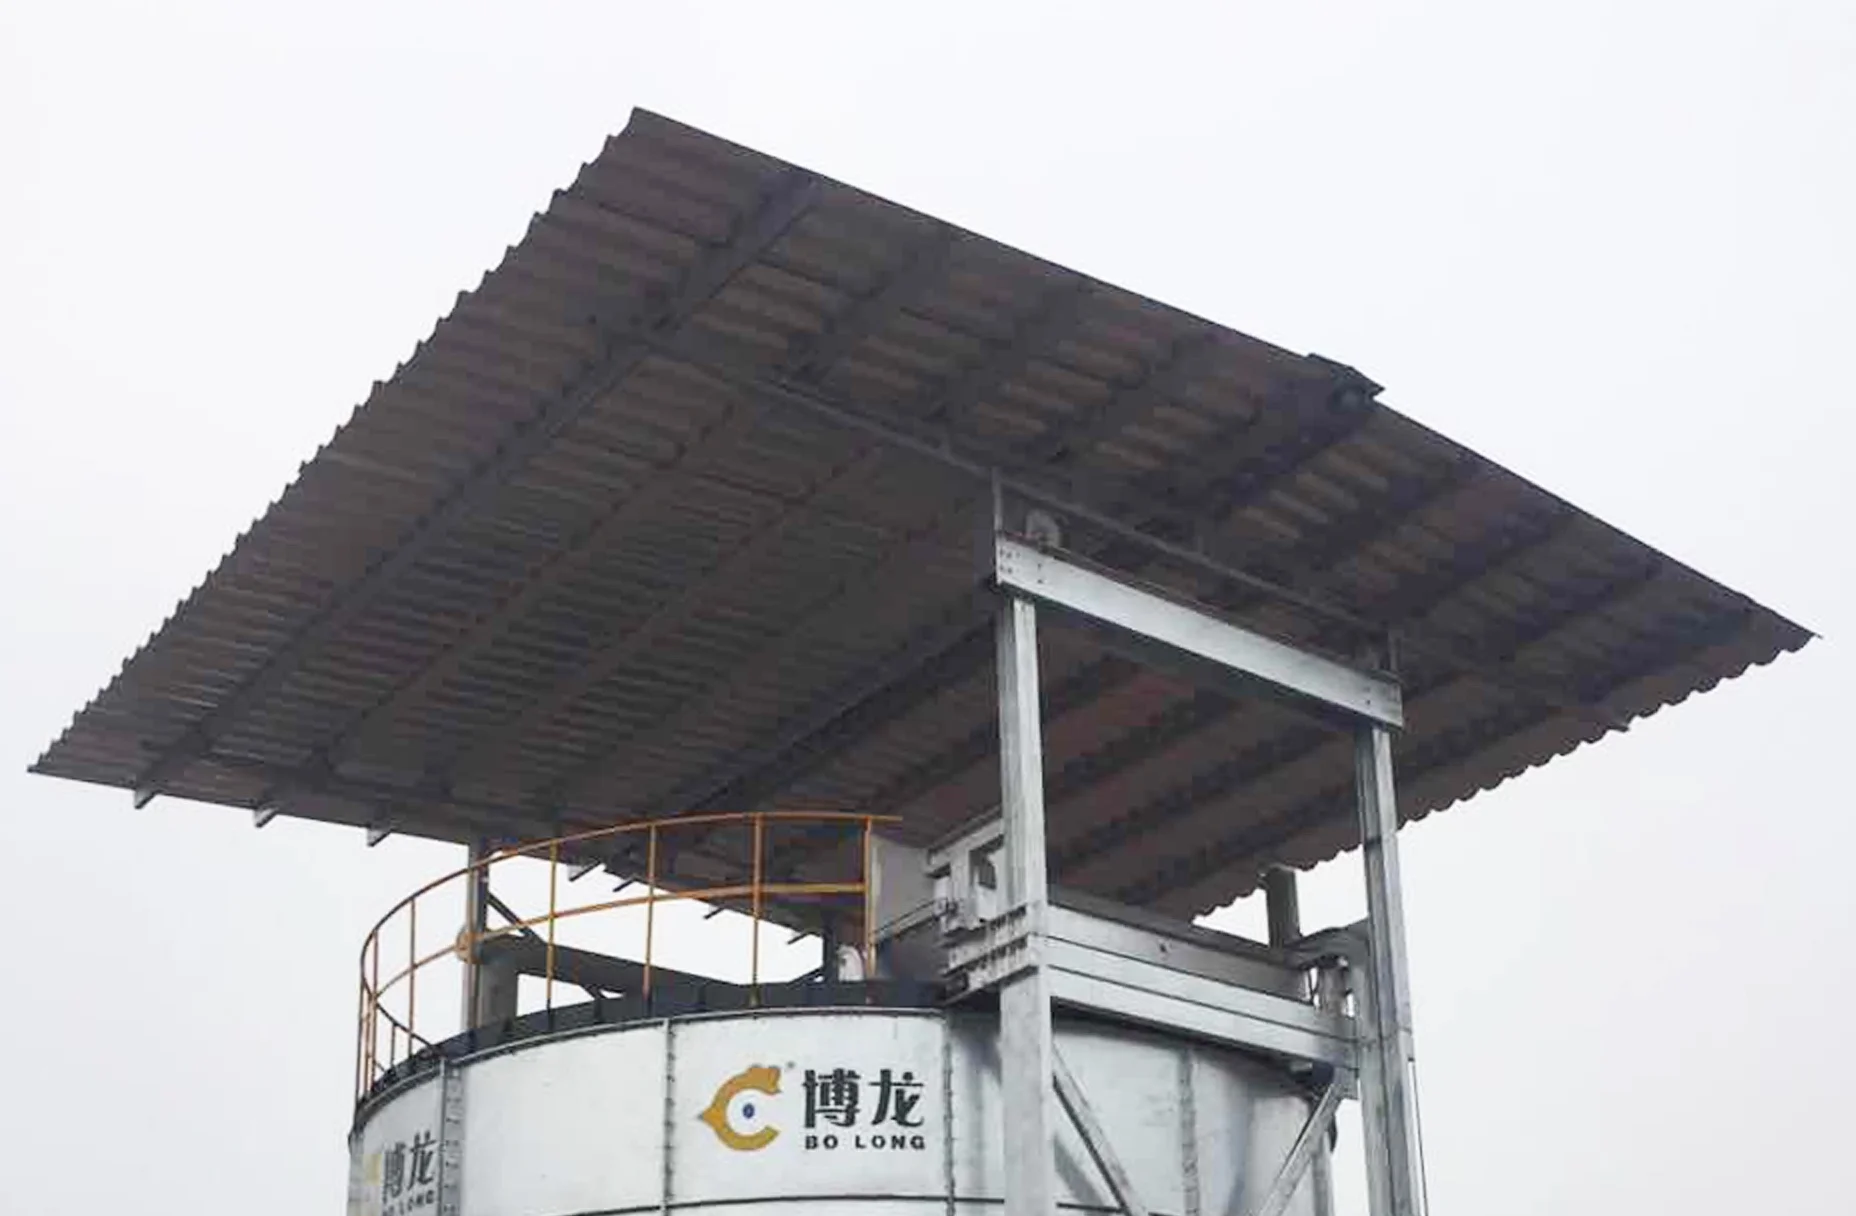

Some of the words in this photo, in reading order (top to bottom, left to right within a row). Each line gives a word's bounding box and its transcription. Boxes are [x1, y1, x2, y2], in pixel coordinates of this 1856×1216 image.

[802, 1069, 925, 1128] 博龙
[805, 1135, 838, 1150] BO
[855, 1135, 925, 1150] LONG
